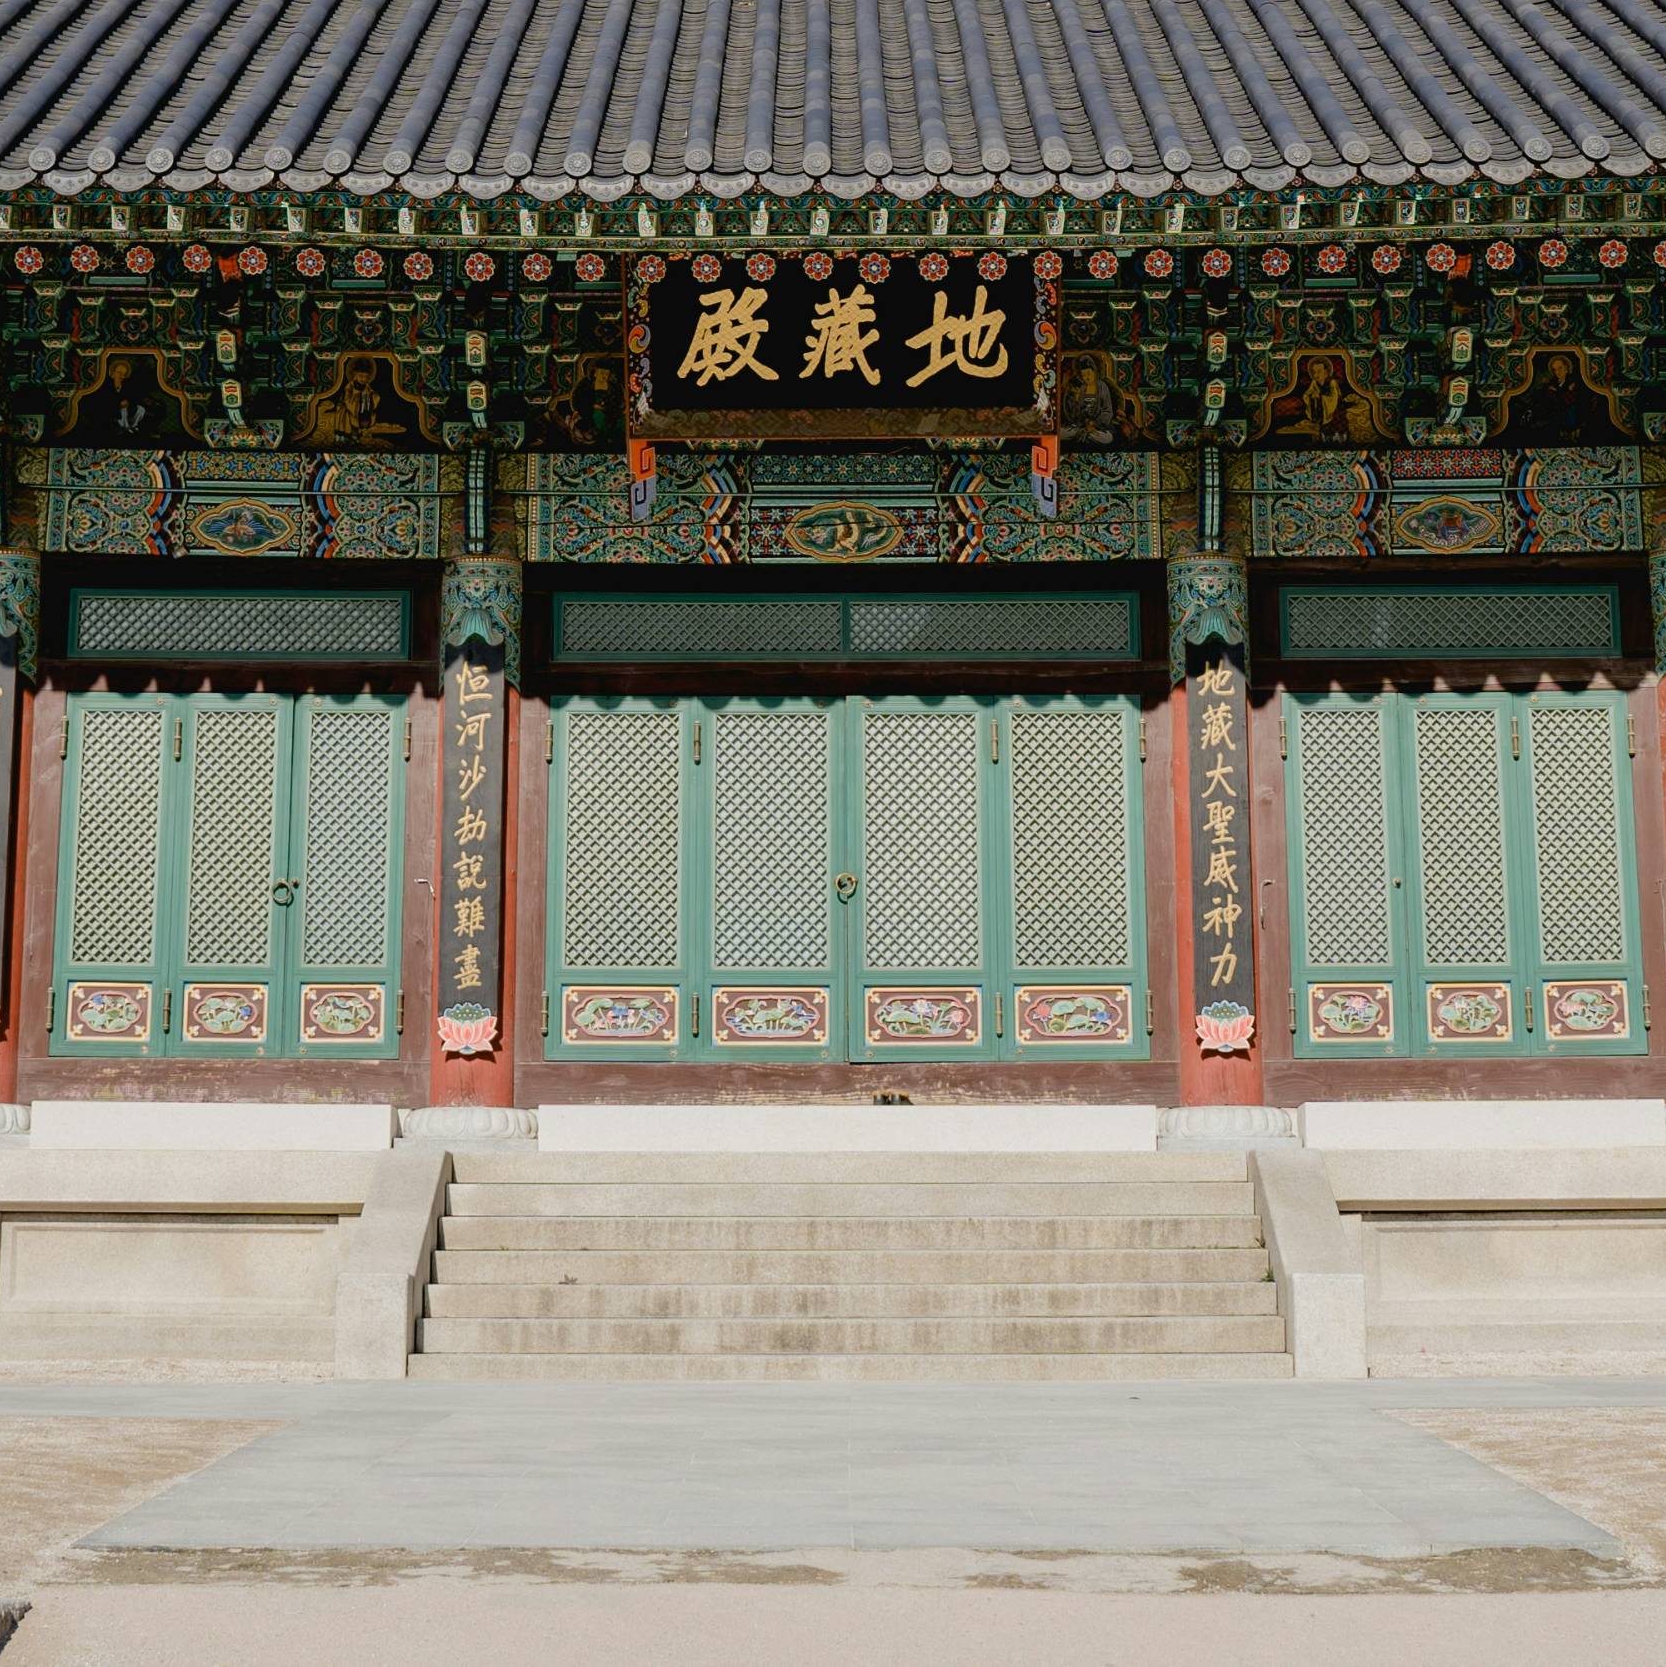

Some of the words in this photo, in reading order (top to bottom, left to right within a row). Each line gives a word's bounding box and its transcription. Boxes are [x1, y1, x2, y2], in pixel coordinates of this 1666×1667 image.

[1195, 660, 1242, 986] 地藏大聖威神力
